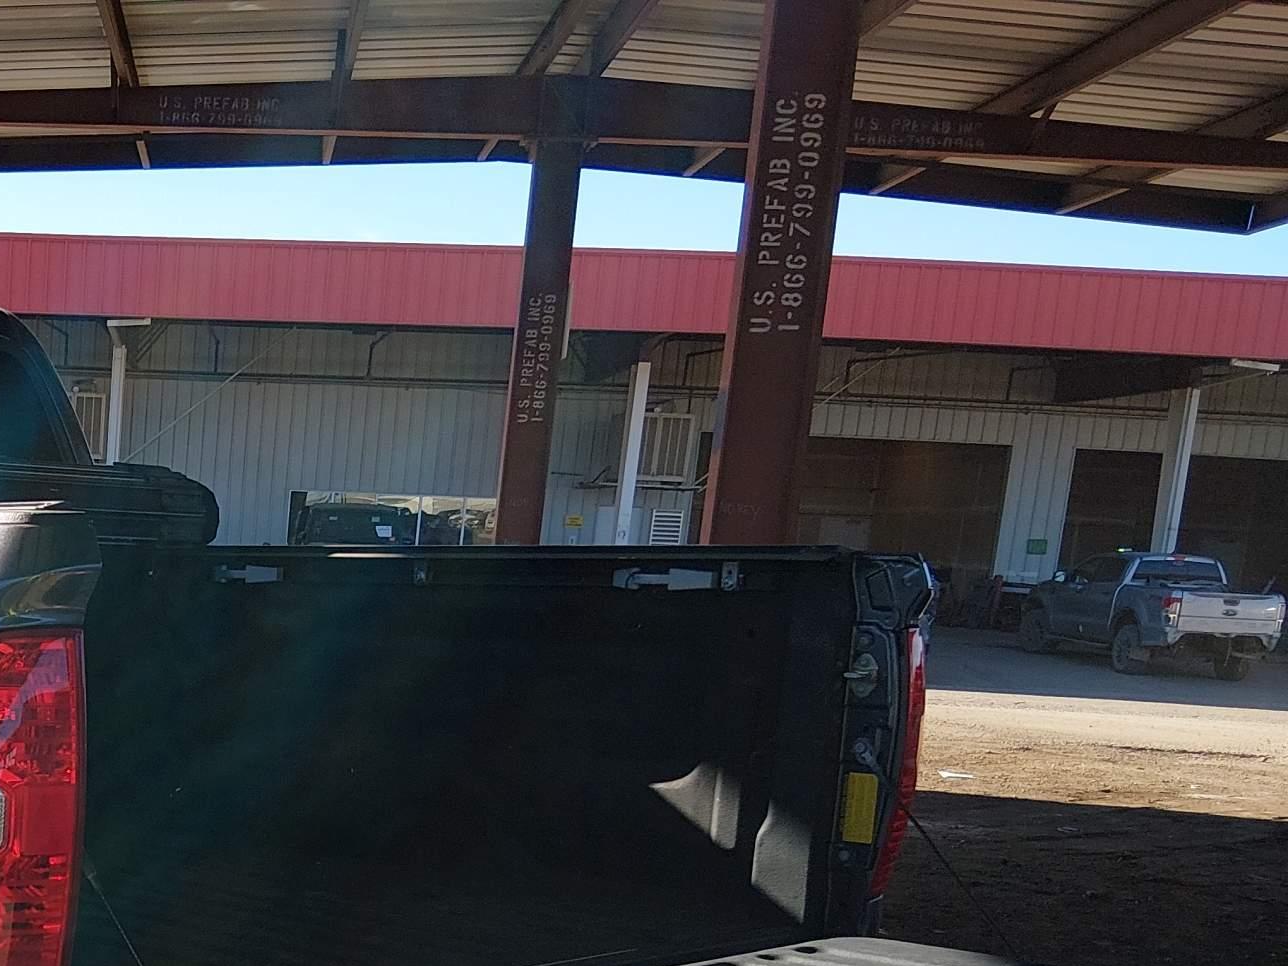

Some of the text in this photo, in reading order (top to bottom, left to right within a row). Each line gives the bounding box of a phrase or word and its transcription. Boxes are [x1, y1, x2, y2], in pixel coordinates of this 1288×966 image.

[194, 96, 249, 111] PREFAB
[749, 91, 799, 333] U.S. PREFAB INC.
[778, 93, 826, 330] 1-866-799-0969
[520, 329, 538, 387] PREFAB
[531, 294, 557, 422] 1-866-799-0969
[517, 395, 531, 423] U.S.
